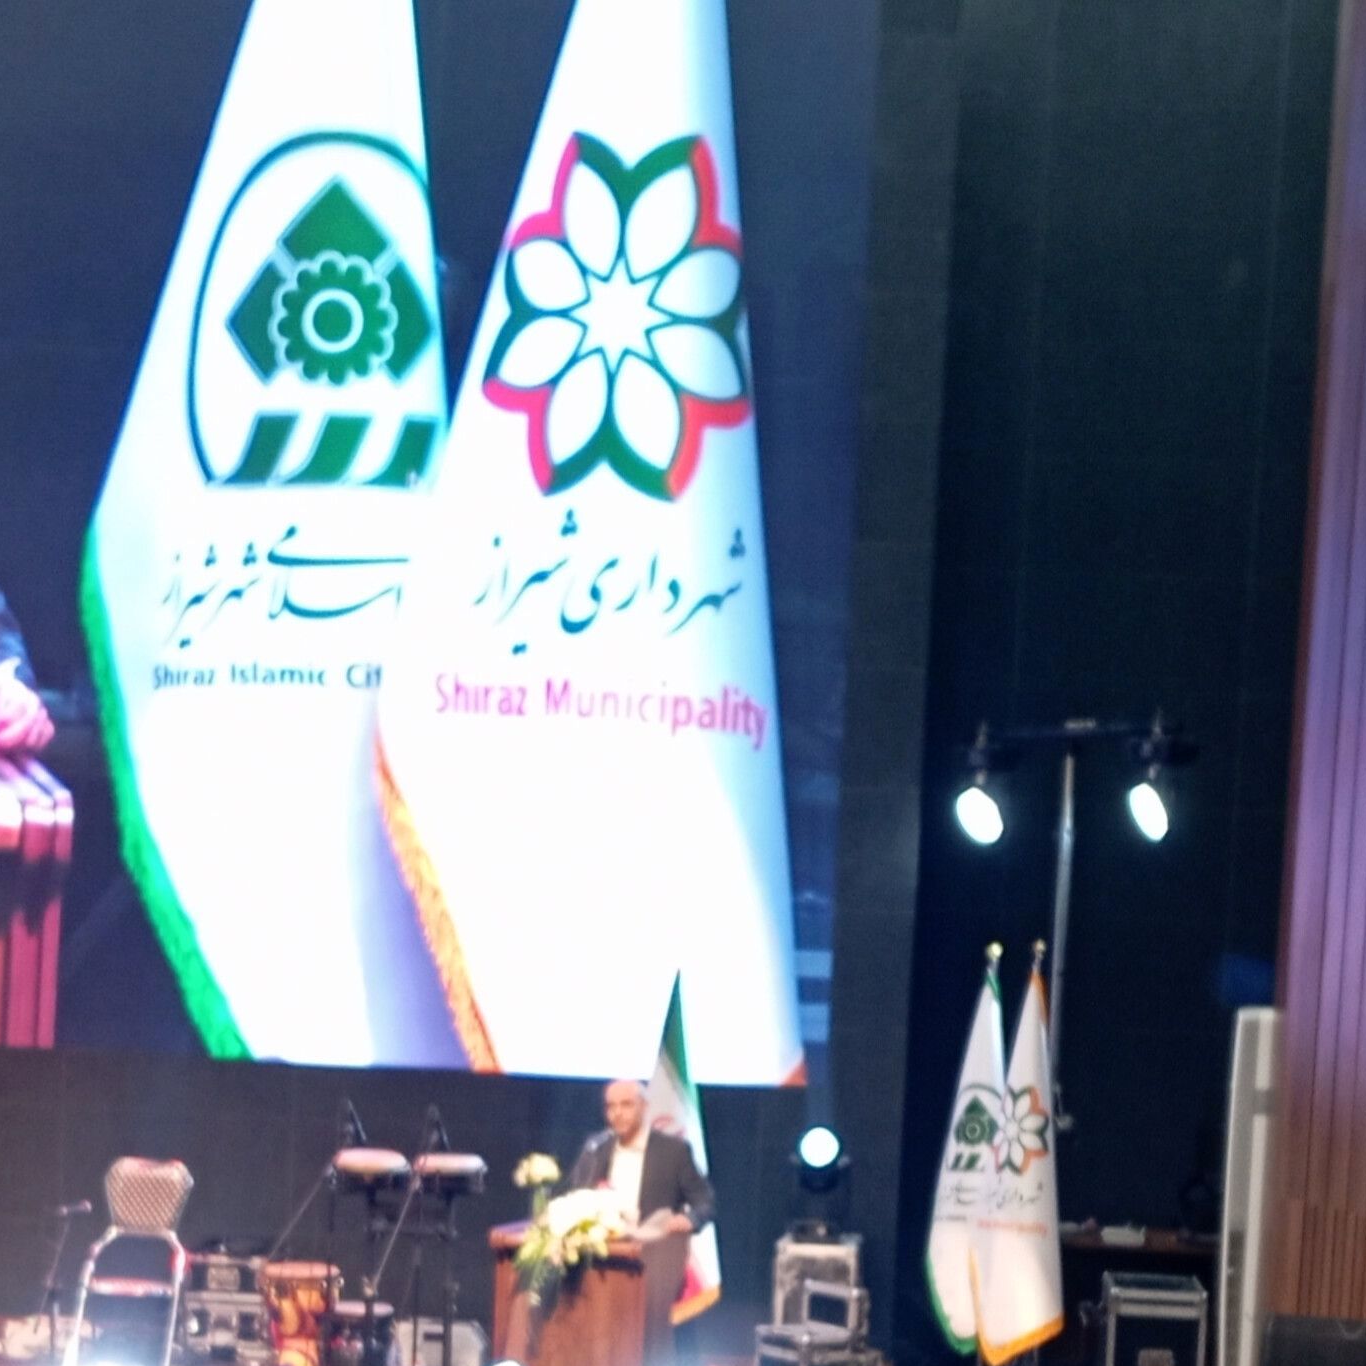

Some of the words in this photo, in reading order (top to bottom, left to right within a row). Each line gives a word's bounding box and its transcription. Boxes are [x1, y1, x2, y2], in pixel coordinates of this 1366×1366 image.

[203, 541, 261, 630] شهر
[471, 507, 579, 656] شیراز
[559, 527, 746, 637] شهرداری
[152, 662, 216, 691] Shiraz
[230, 661, 327, 687] Islamic
[435, 673, 528, 717] Shiraz
[545, 676, 767, 752] Municipality
